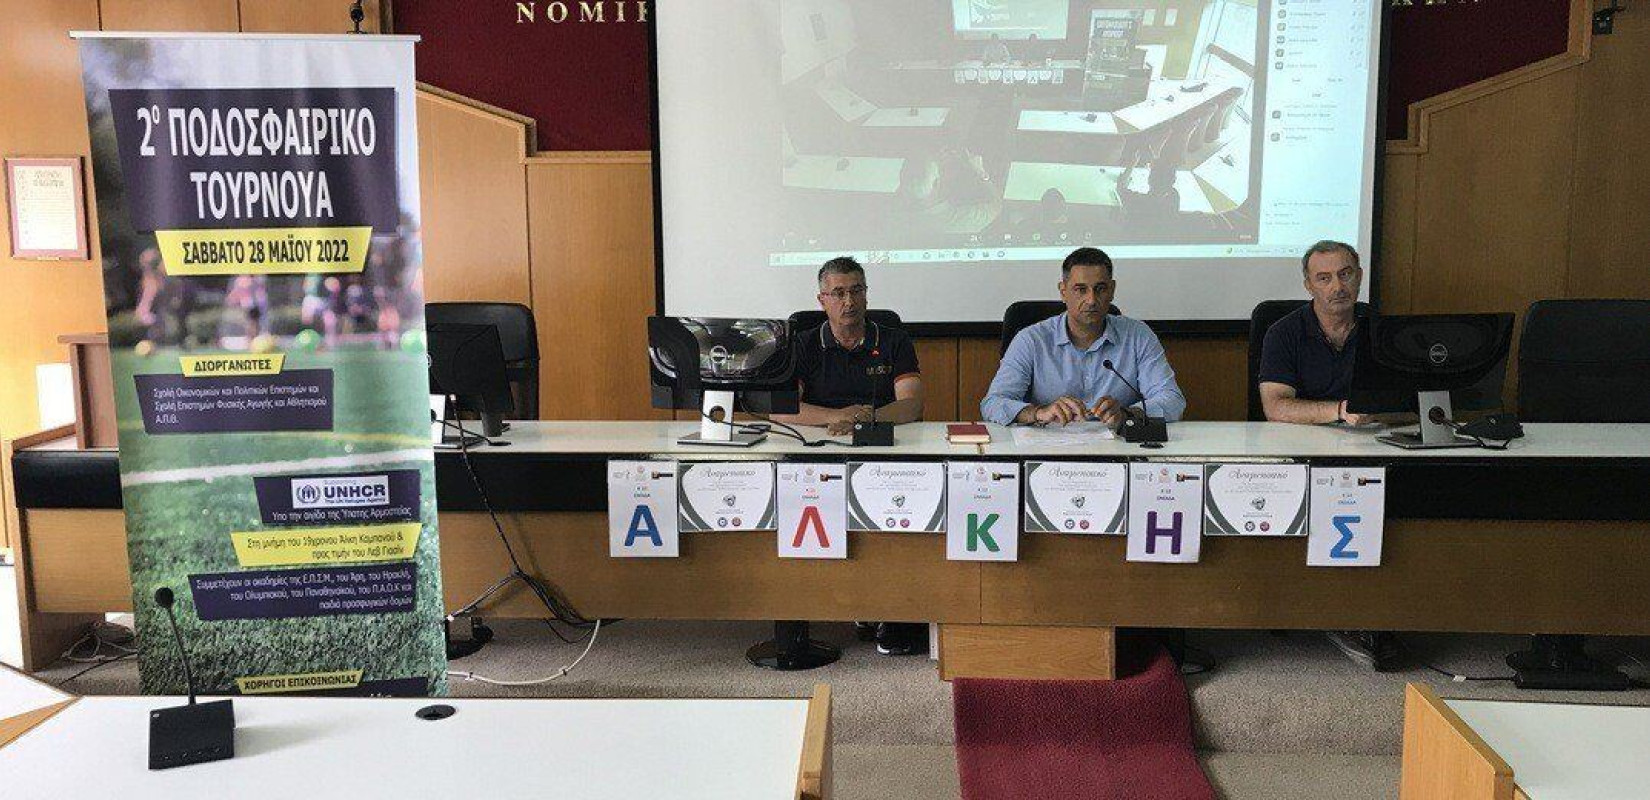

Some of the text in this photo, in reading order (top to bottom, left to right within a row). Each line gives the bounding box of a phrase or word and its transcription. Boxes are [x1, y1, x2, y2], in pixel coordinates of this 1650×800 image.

[168, 107, 376, 157] ΠΟΔΟΣΦΑΙΡΙΚΟ
[190, 171, 334, 220] ΤΟΥΡΝΟΥΑ
[182, 234, 349, 264] ΣΑΒΒΑΤΟ 28 ΜΑΪΟΥ 2022
[194, 359, 272, 371] ΔΙΟΡΓΑΝΩΤΕΣ
[153, 387, 175, 399] Σχολή
[222, 386, 232, 395] και
[308, 385, 319, 393] και
[274, 399, 286, 407] και
[324, 484, 385, 499] UNHCR
[624, 505, 663, 547] Α
[792, 506, 830, 548] Λ
[966, 513, 1000, 552] Κ
[1145, 511, 1182, 554] Η
[247, 538, 260, 549] Στη
[288, 538, 300, 547] του
[397, 530, 403, 540] &
[1330, 516, 1361, 559] Σ
[352, 548, 365, 557] του
[336, 573, 348, 582] του
[368, 572, 381, 581] του
[230, 592, 243, 601] του
[291, 590, 303, 598] του
[358, 586, 371, 595] του
[244, 674, 358, 690] ΧΟΡΗΓΟΙ ΕΠΙΚΟΙΝΩΝΙΑΣ
